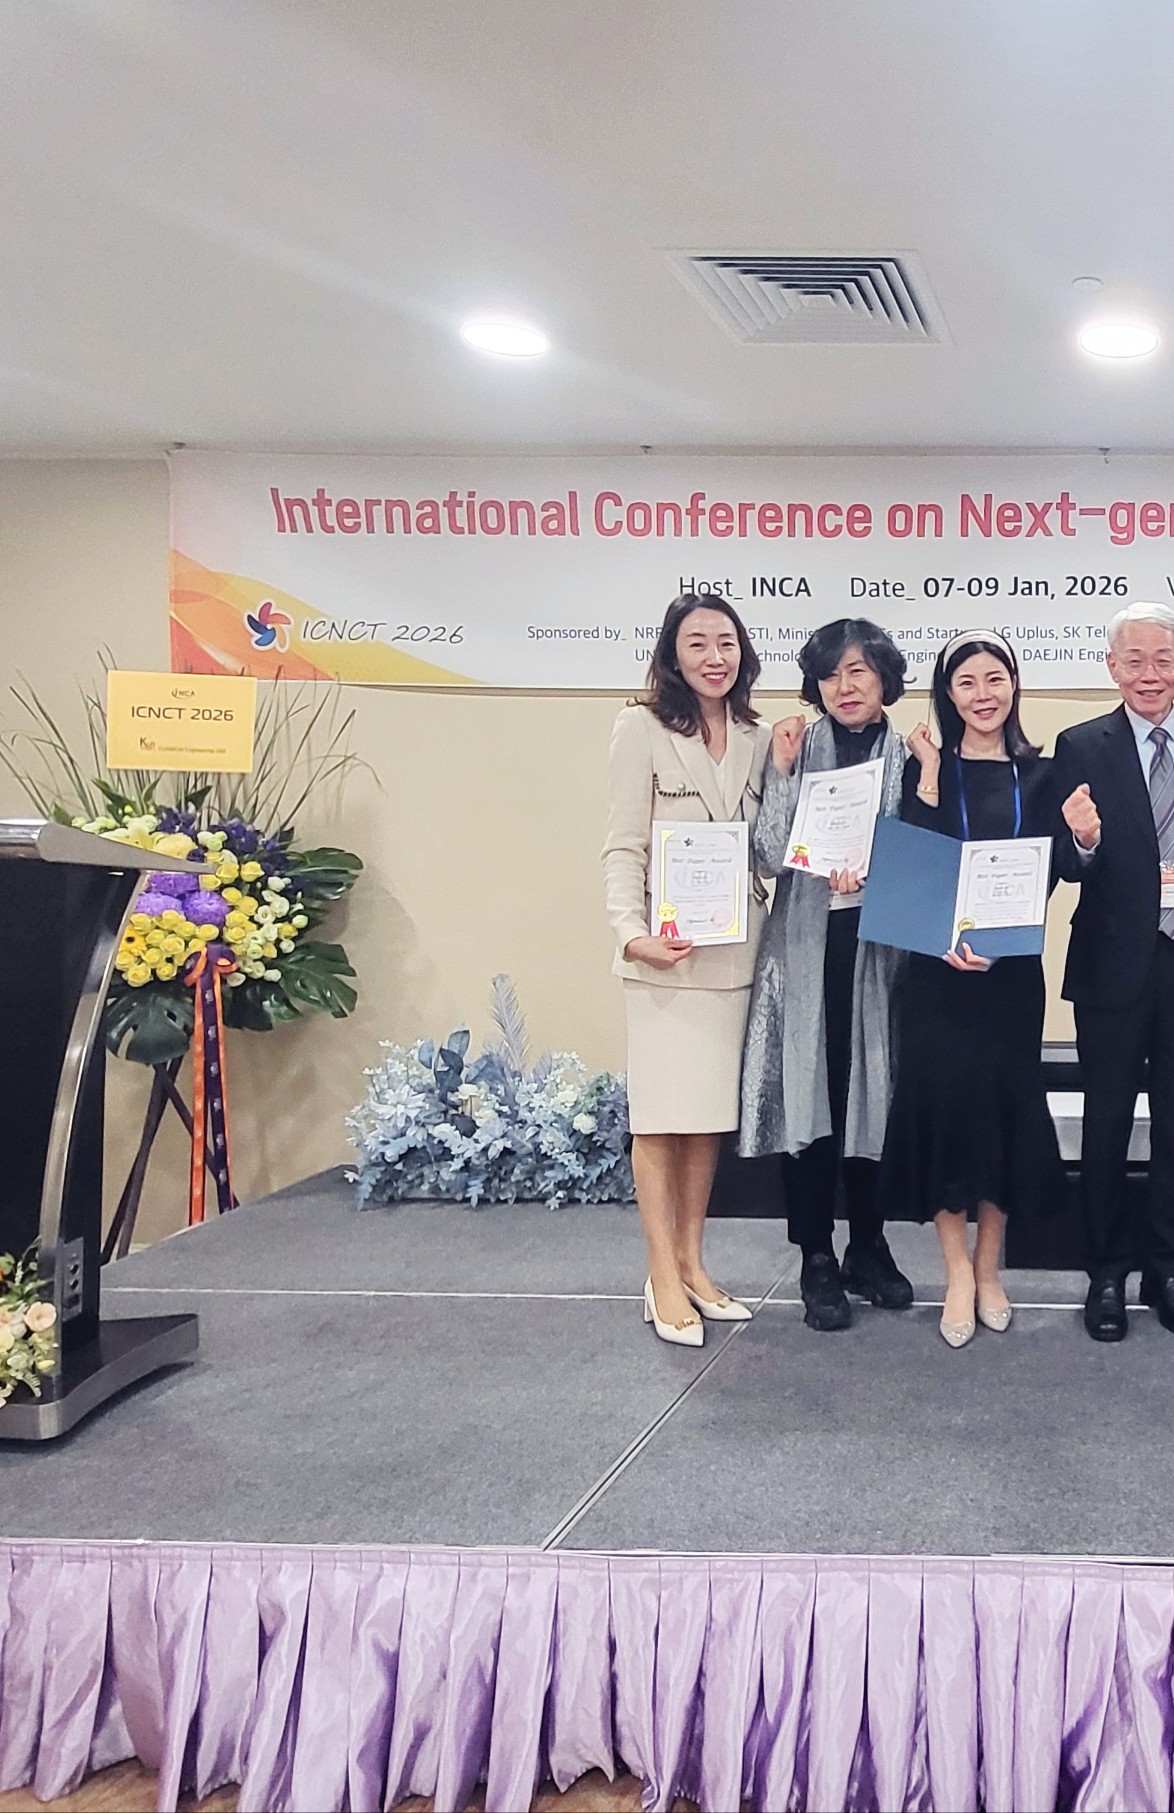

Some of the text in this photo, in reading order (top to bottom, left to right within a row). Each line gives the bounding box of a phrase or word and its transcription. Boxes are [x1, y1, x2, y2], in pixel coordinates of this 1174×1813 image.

[270, 487, 580, 537] International
[594, 491, 873, 539] Conference
[886, 502, 943, 538] on
[751, 577, 812, 598] INCA
[923, 577, 998, 598] 07-09
[1007, 577, 1056, 600] Jan,
[1065, 576, 1129, 597] 2026
[302, 619, 464, 644] ICNCT 2026
[527, 625, 599, 641] Sponsored
[898, 626, 922, 640] and
[927, 627, 962, 640] Start
[1016, 626, 1058, 641] Uplus,
[1063, 626, 1081, 639] SK
[1022, 648, 1073, 661] DAEJIN
[131, 706, 234, 721] ICNCT 2026
